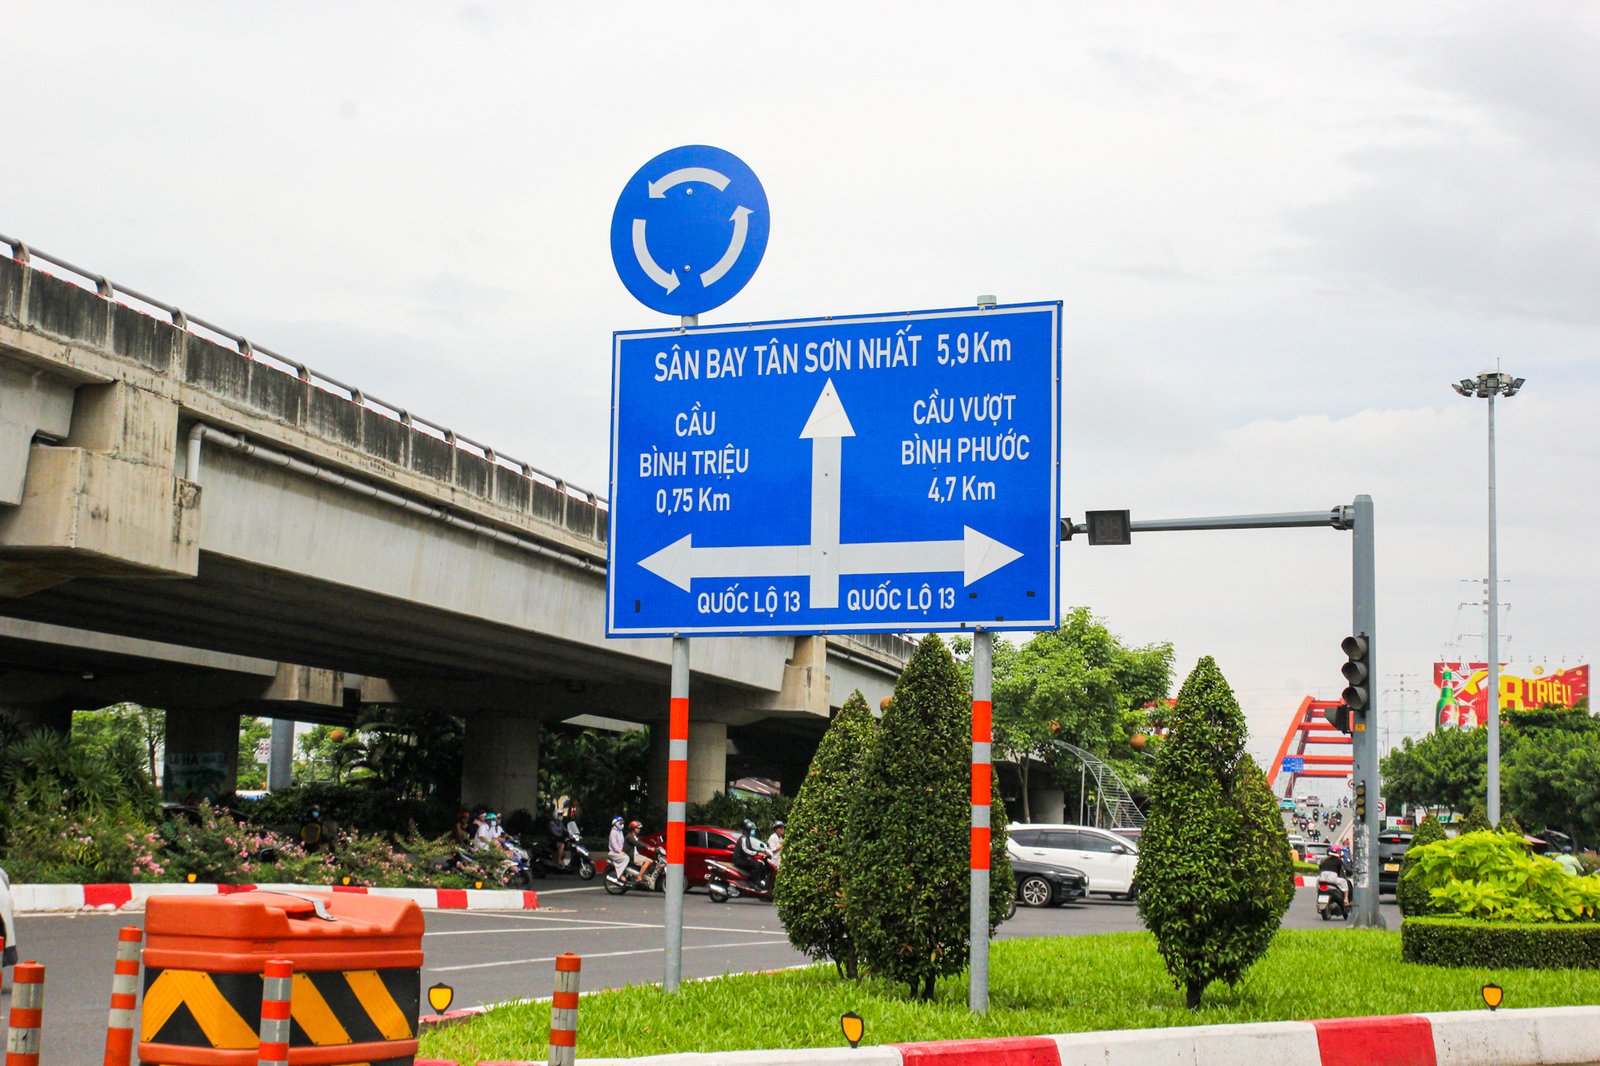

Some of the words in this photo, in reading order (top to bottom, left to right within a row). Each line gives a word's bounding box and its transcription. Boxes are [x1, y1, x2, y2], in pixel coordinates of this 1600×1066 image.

[654, 344, 700, 382] SÂN
[706, 347, 748, 379] BAY
[753, 337, 799, 376] TÂN
[804, 337, 852, 373] SƠN
[858, 324, 922, 370] NHẤT
[675, 401, 716, 437] CẦU
[913, 388, 954, 425] CẦU
[959, 393, 1017, 426] VƯỢT
[639, 444, 687, 478] BÌNH
[691, 443, 749, 480] TRIỆU
[901, 432, 951, 465] BÌNH
[957, 428, 1030, 461] PHƯỚC
[656, 487, 694, 517] 0,75
[698, 487, 731, 512] Km
[927, 476, 957, 504] 4,7
[963, 475, 996, 501] Km
[697, 583, 749, 614] QUỐC
[754, 586, 779, 618] LỘ
[783, 590, 801, 613] 13
[847, 580, 902, 611] QUỐC
[906, 583, 931, 614] LỘ
[937, 587, 956, 610] 13
